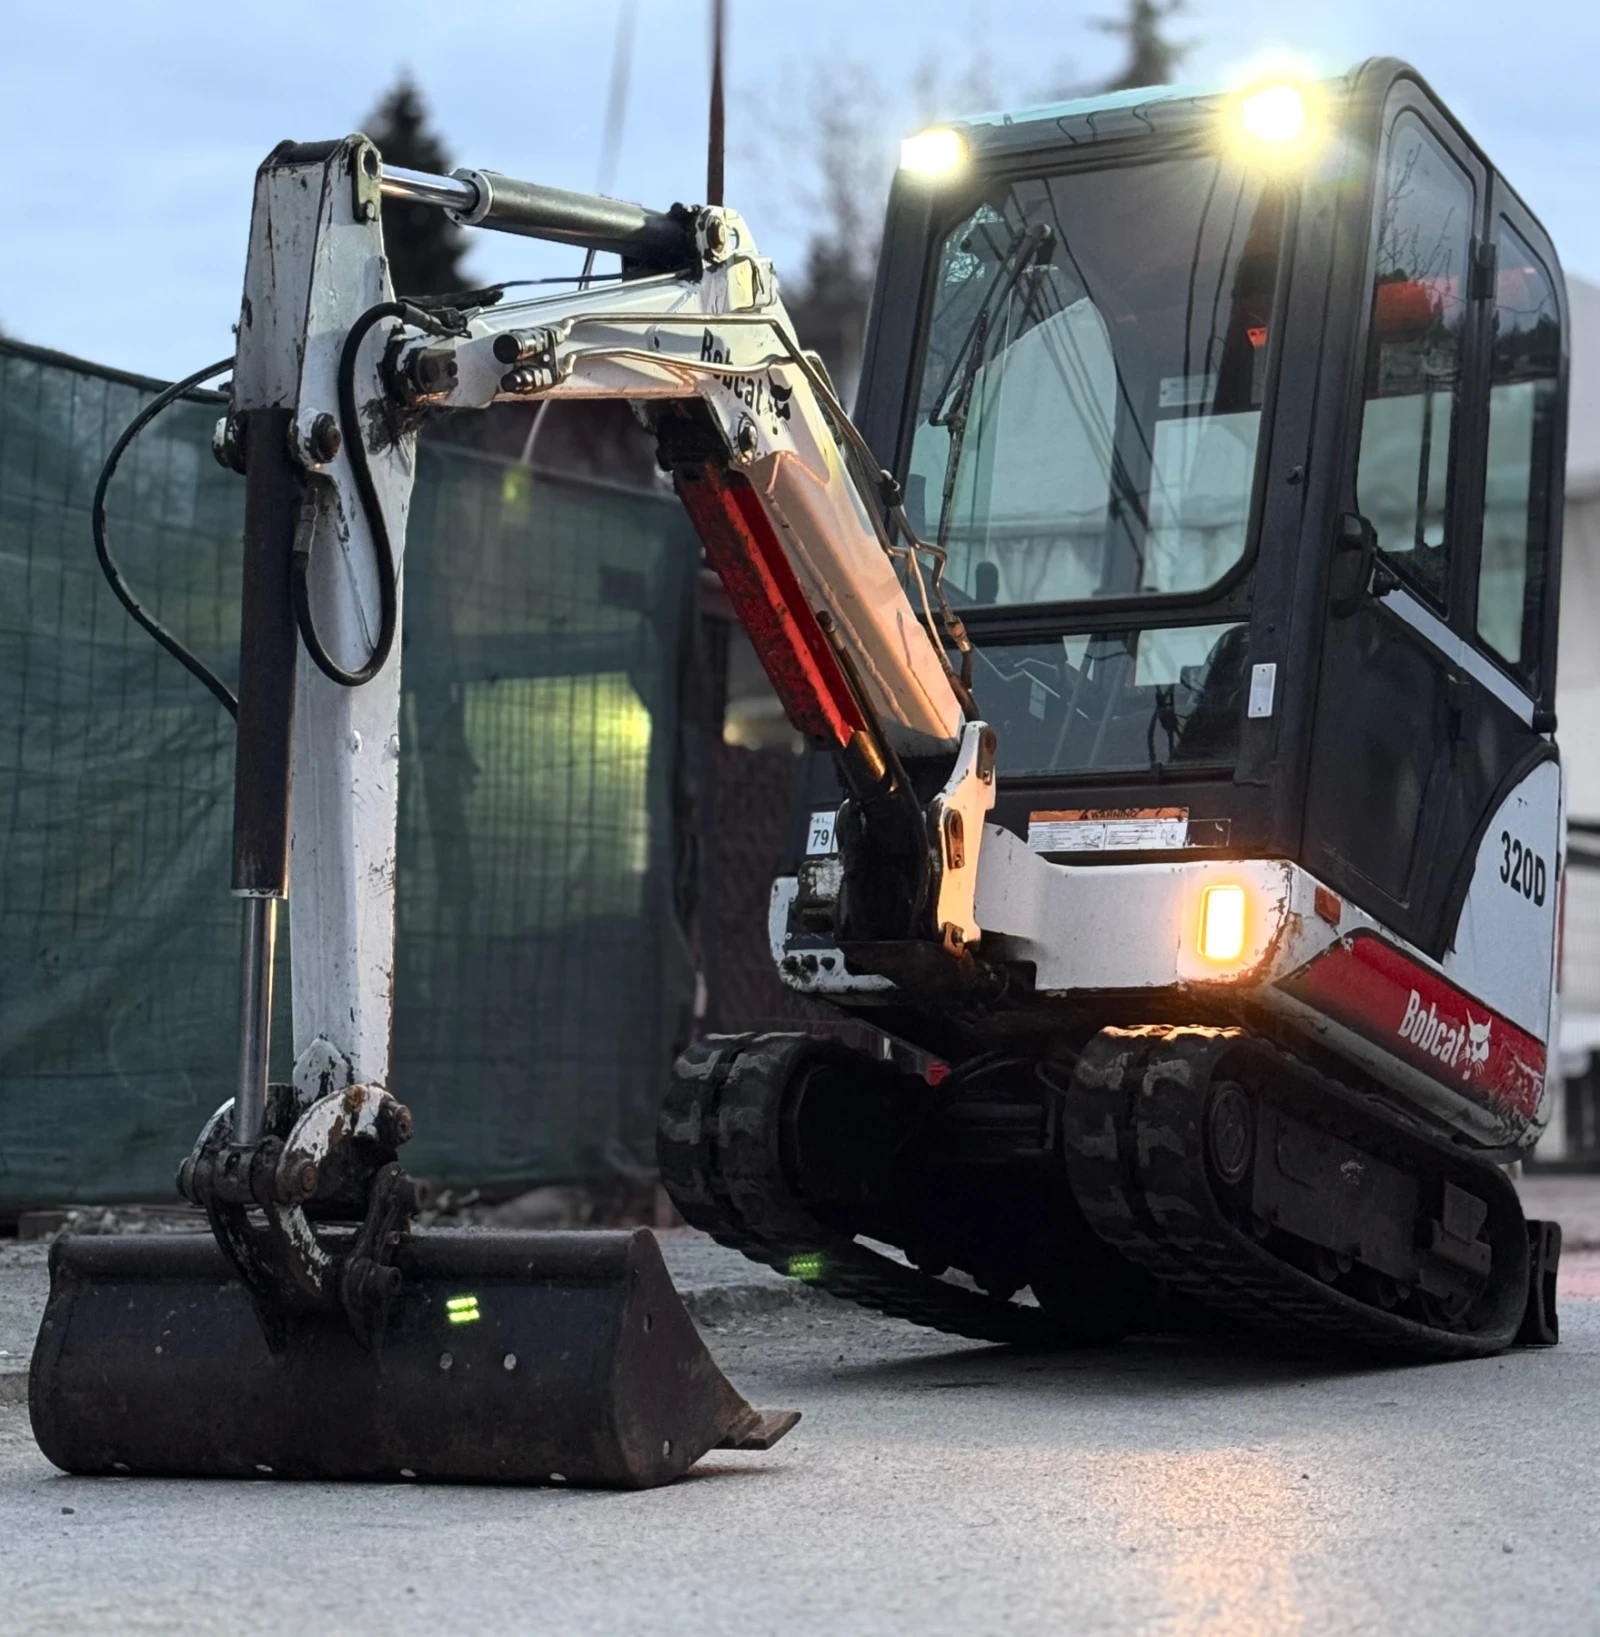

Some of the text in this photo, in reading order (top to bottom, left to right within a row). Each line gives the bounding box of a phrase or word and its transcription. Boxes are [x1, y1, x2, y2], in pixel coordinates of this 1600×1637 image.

[701, 326, 763, 416] Bobcat
[812, 829, 829, 847] 79
[1500, 830, 1546, 907] 320D
[1397, 988, 1465, 1068] Bobcat
